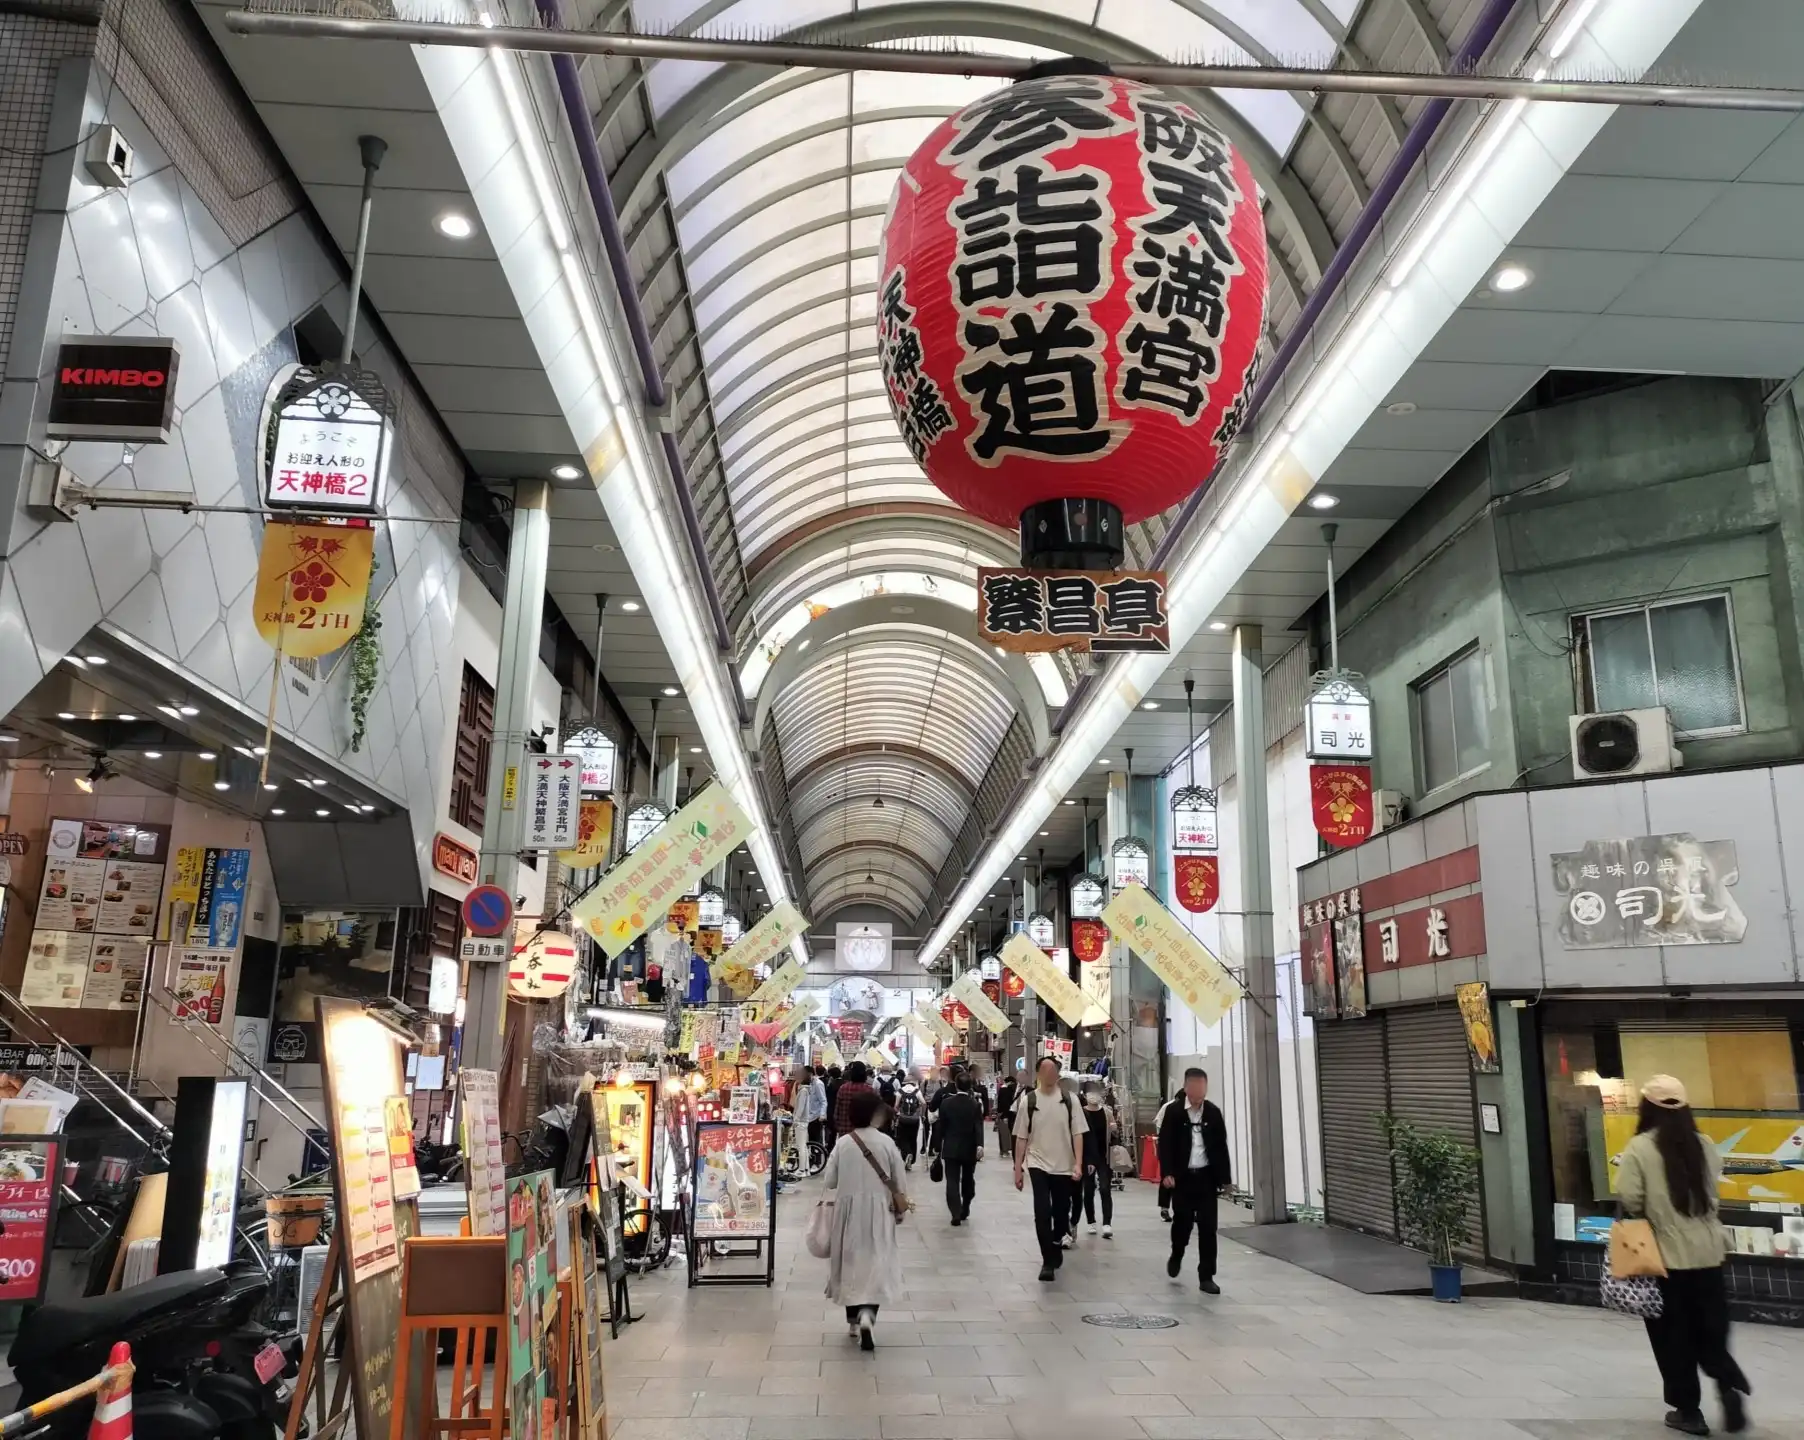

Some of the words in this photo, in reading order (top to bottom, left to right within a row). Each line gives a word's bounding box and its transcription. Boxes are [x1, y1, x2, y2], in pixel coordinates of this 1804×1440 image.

[949, 76, 1116, 460] 参詣道
[61, 367, 165, 387] KIMBO
[299, 430, 358, 448] ようこそ
[286, 452, 364, 468] お迎え人形の
[277, 469, 368, 497] 天神橋2
[263, 606, 349, 630] 天神橋2丁目
[981, 575, 1167, 636] 繁昌亭
[1320, 730, 1365, 748] 司光
[533, 774, 550, 833] 天満天神繁昌亭
[555, 774, 571, 833] 大阪天満宮北門
[1177, 833, 1214, 845] 天神橋2
[1580, 856, 1707, 879] 趣味の呉服
[1303, 888, 1361, 926] 趣味の呉服
[1615, 885, 1728, 927] 司光
[1379, 907, 1450, 963] 司光
[462, 943, 505, 957] 自動車
